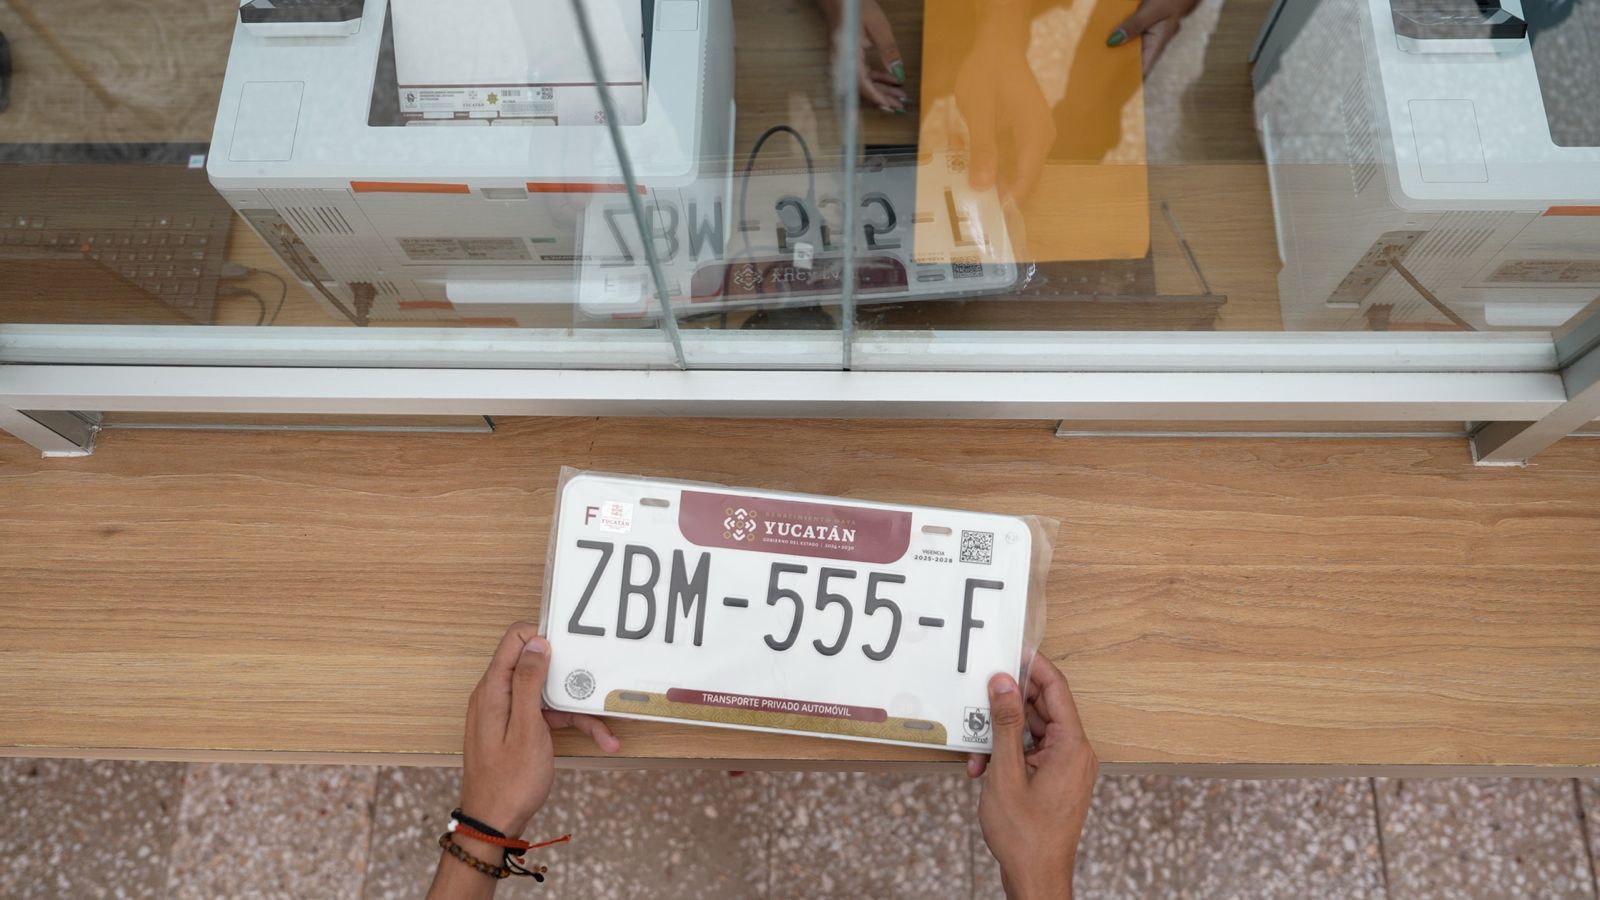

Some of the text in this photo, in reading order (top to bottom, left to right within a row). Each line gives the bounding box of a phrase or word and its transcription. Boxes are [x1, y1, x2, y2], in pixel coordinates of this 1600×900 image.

[585, 506, 599, 525] F
[764, 520, 856, 542] YUCATÁN
[567, 538, 1005, 674] ZBM-555-F
[702, 693, 852, 717] TRANSPORTE PRIVADO AUTOMÓVIL
